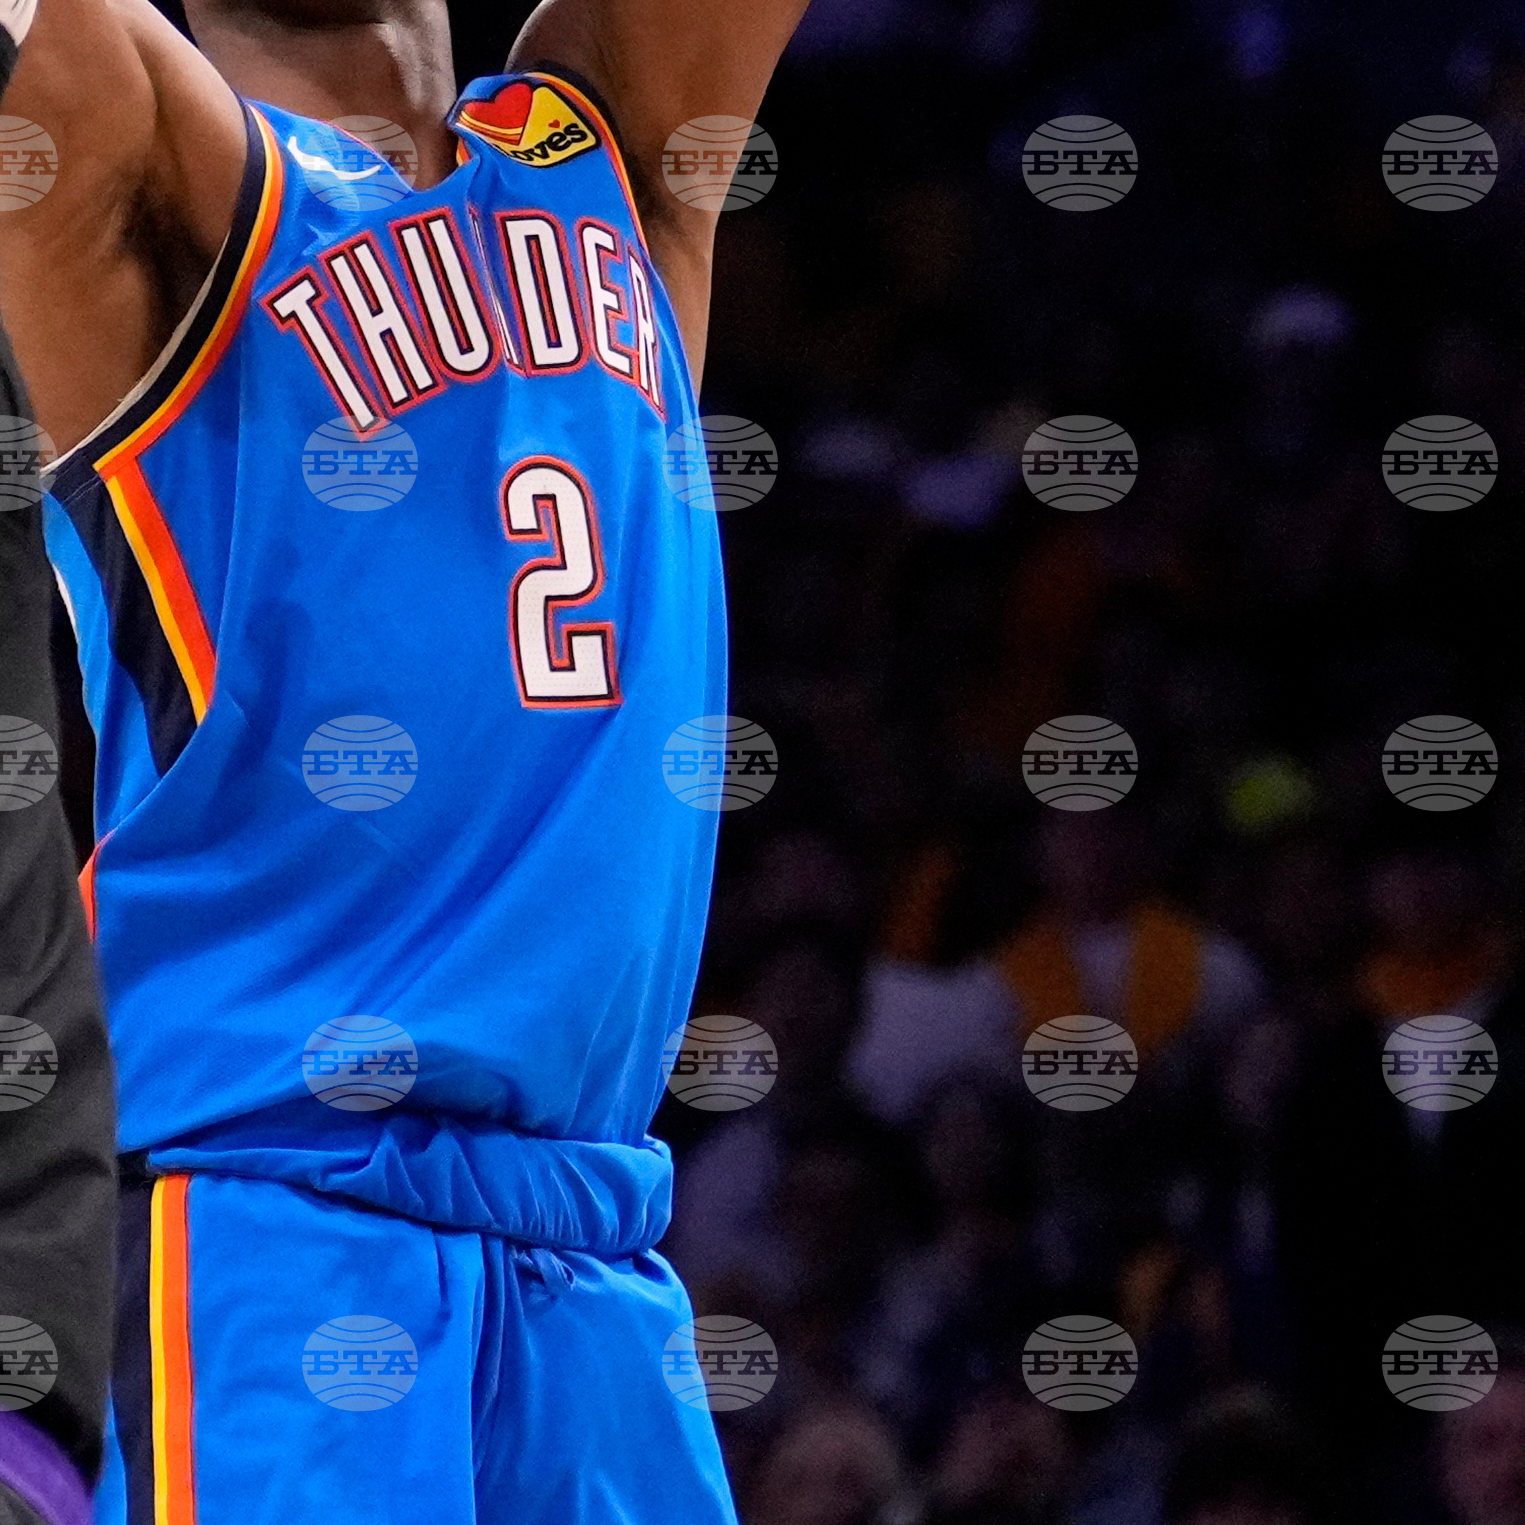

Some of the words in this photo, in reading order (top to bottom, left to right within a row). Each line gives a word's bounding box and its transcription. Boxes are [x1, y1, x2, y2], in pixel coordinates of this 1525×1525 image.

[495, 123, 588, 162] oves
[259, 206, 668, 443] THUDER
[499, 454, 624, 708] 2
